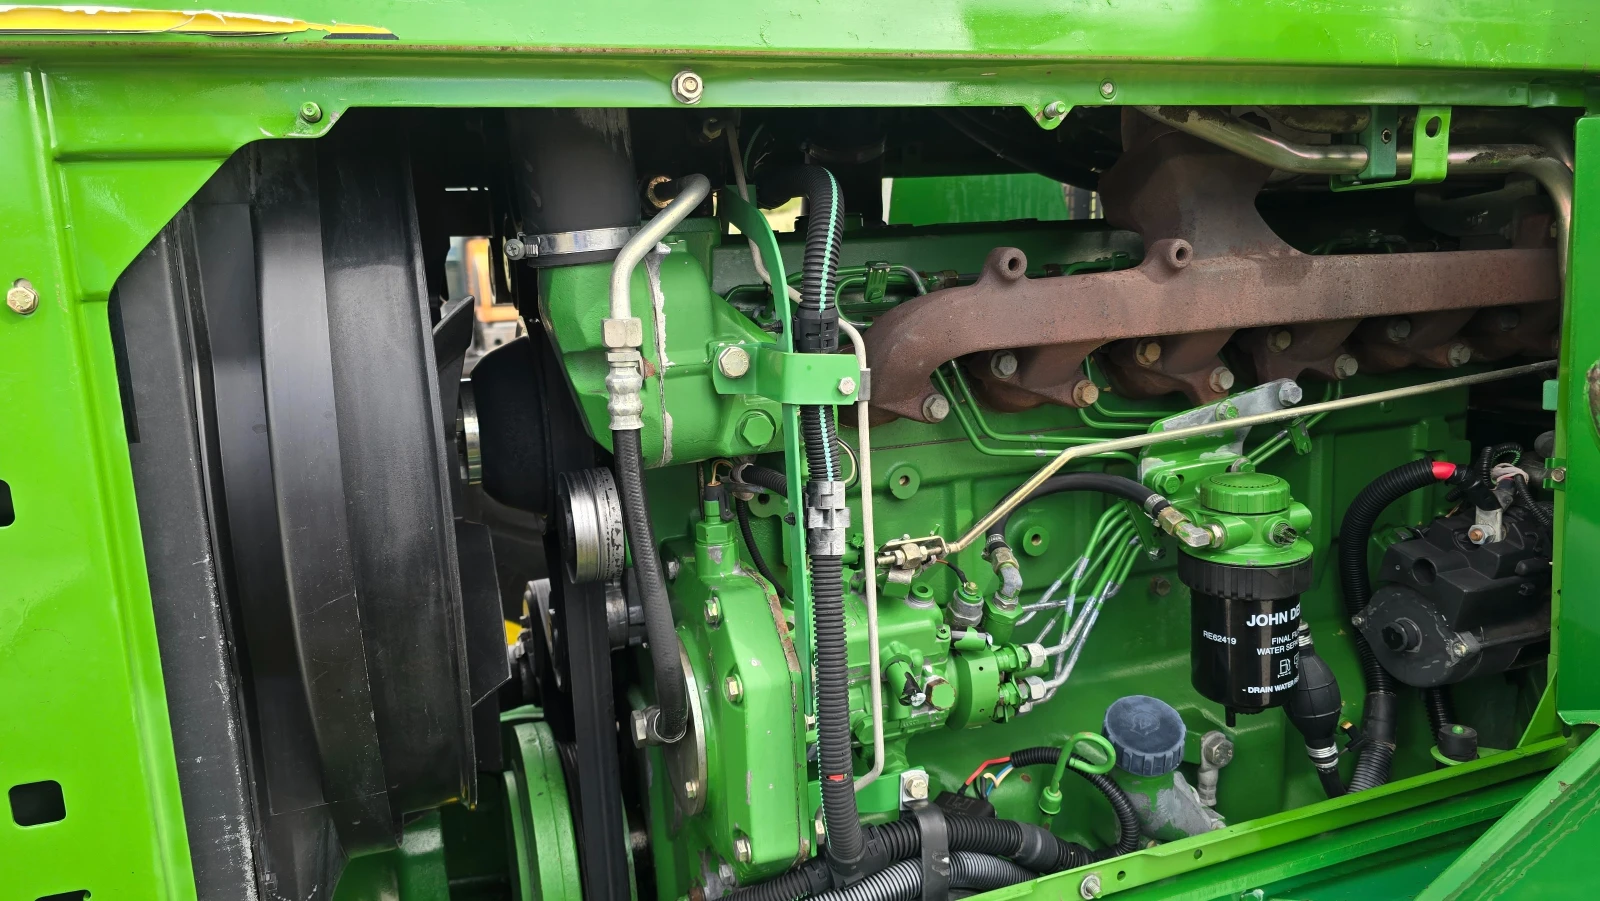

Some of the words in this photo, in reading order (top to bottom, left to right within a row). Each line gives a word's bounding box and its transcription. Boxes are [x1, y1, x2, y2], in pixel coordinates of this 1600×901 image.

[1246, 610, 1288, 627] JOHN
[1290, 602, 1301, 620] DE
[1203, 630, 1237, 645] RE62419
[1271, 634, 1291, 645] FINAL
[1256, 645, 1285, 656] WATER
[1247, 685, 1273, 694] DRAIN
[1274, 680, 1294, 692] WATER
